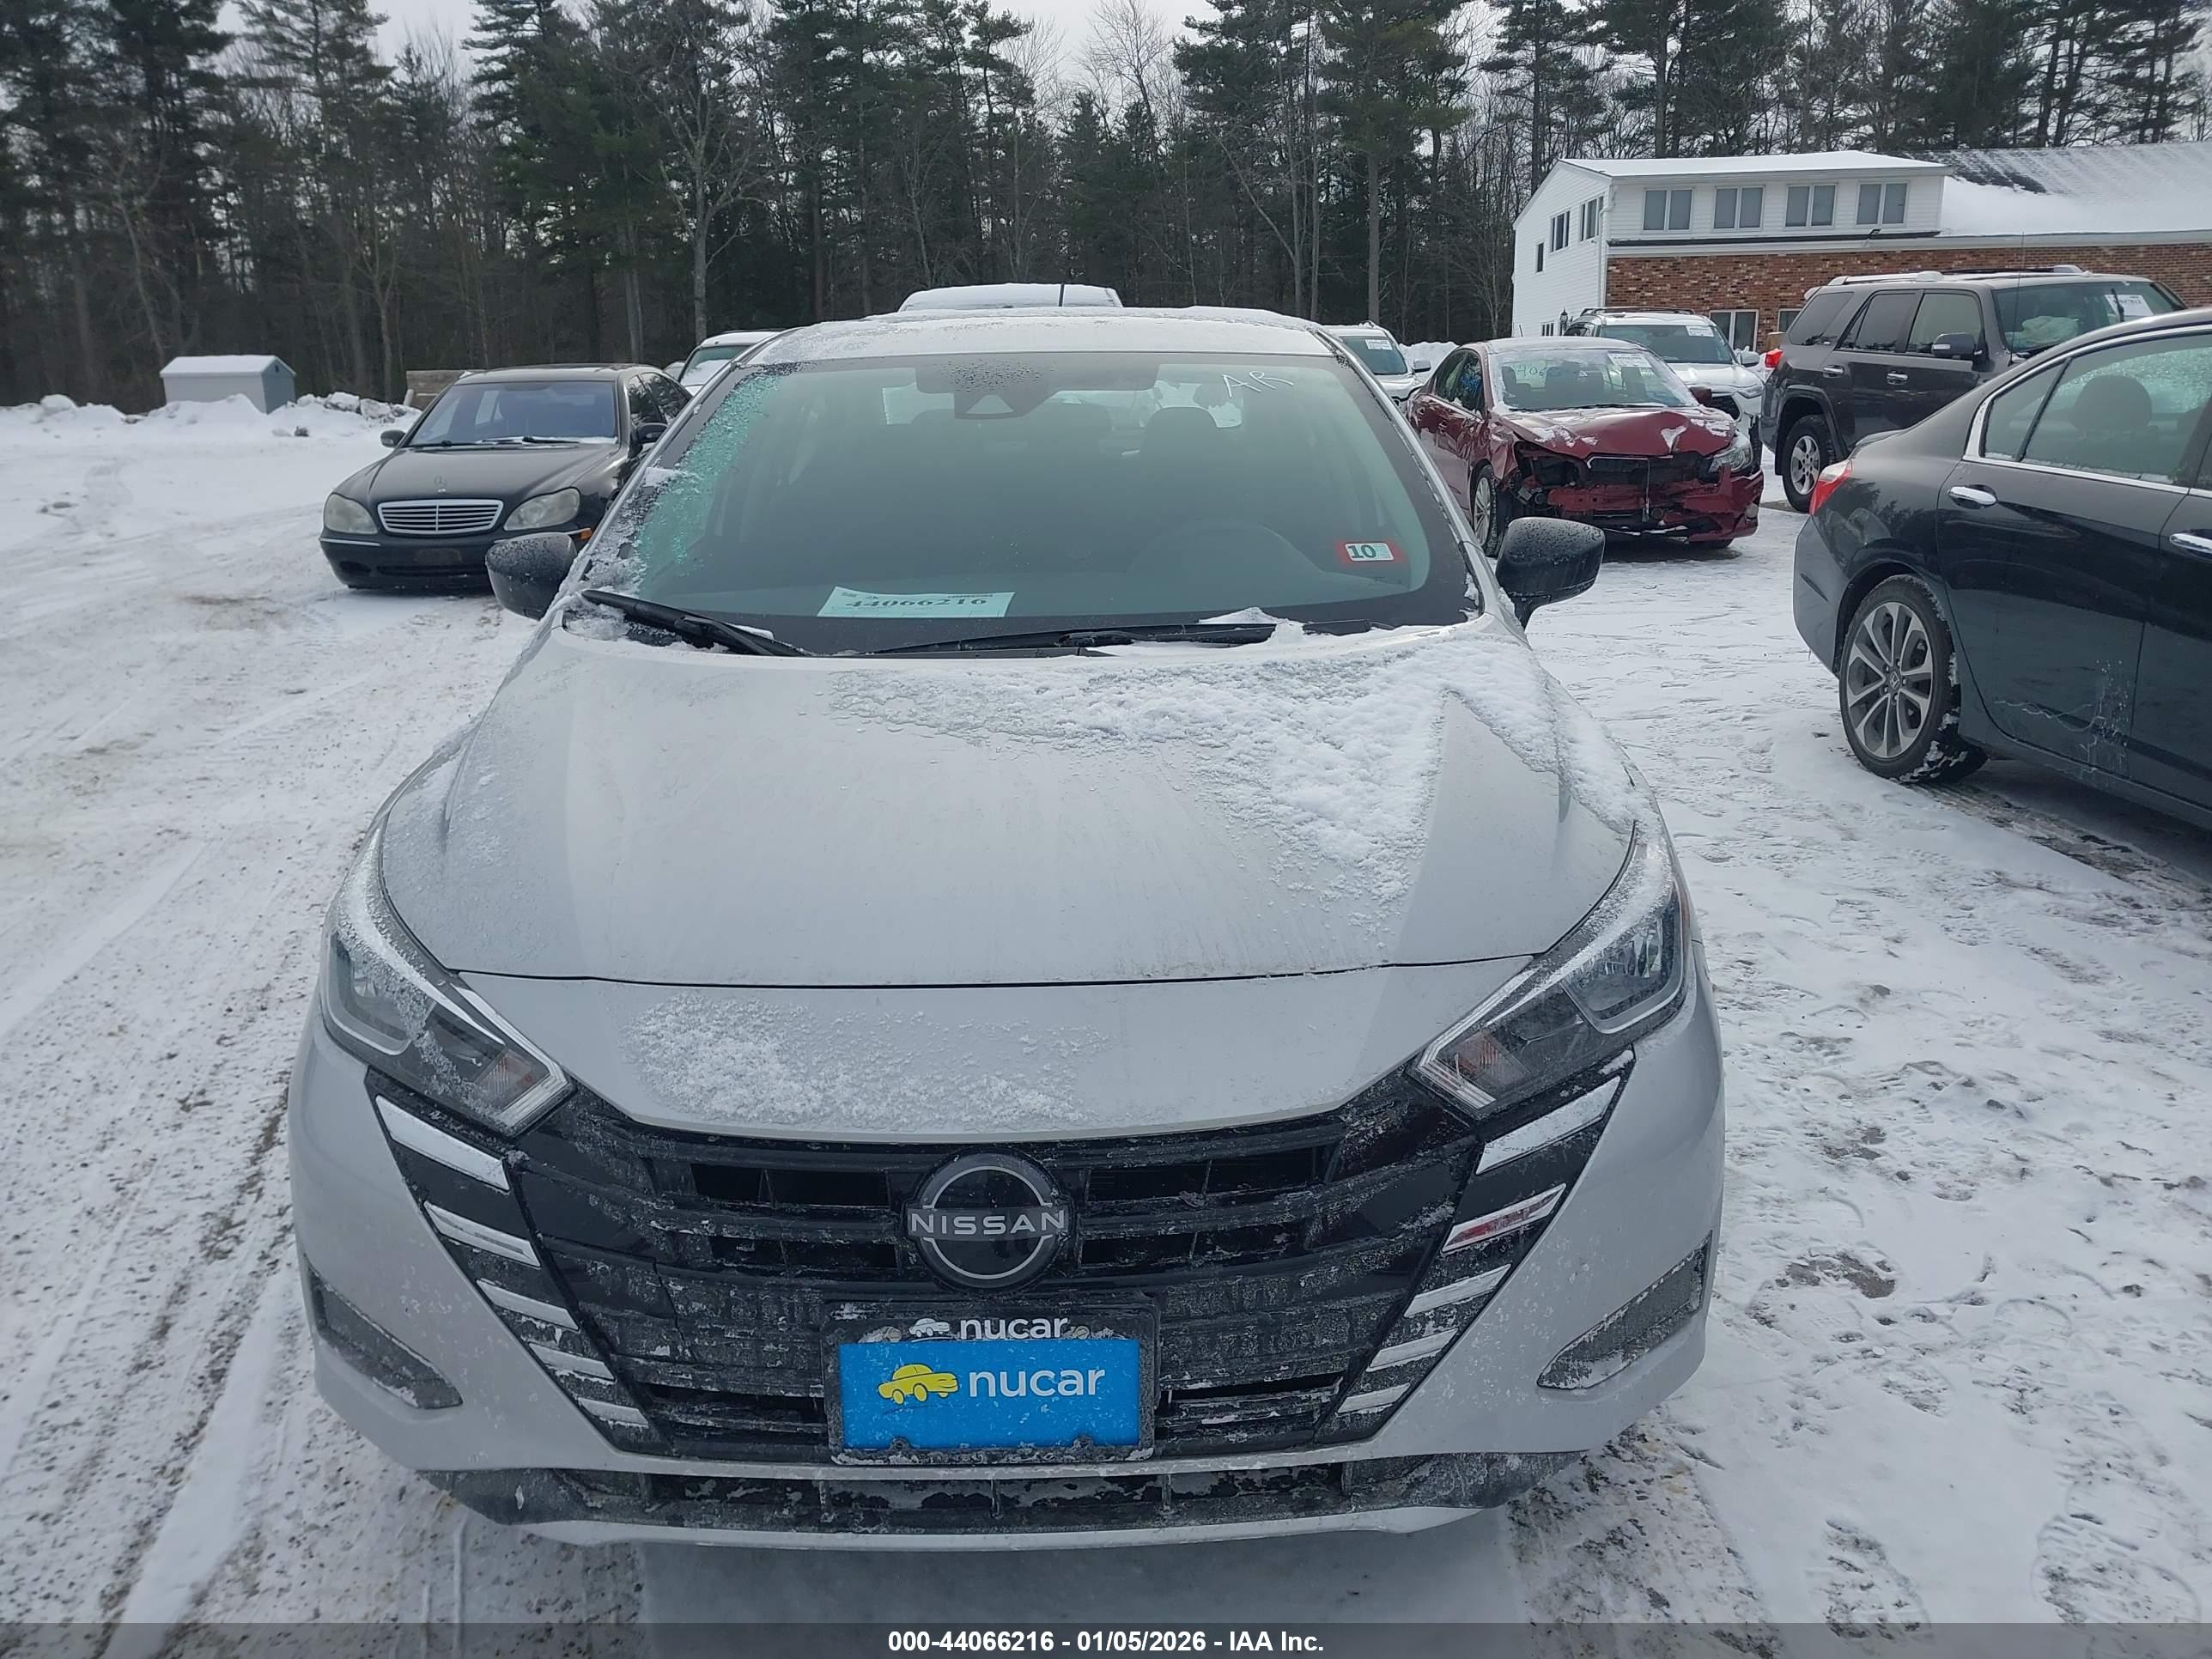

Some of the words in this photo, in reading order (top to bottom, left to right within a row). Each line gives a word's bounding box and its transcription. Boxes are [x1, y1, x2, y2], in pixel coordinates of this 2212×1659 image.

[1347, 544, 1376, 559] 10
[911, 1211, 1065, 1235] NISSAN
[960, 1316, 1069, 1340] nucar
[969, 1369, 1105, 1397] nucar
